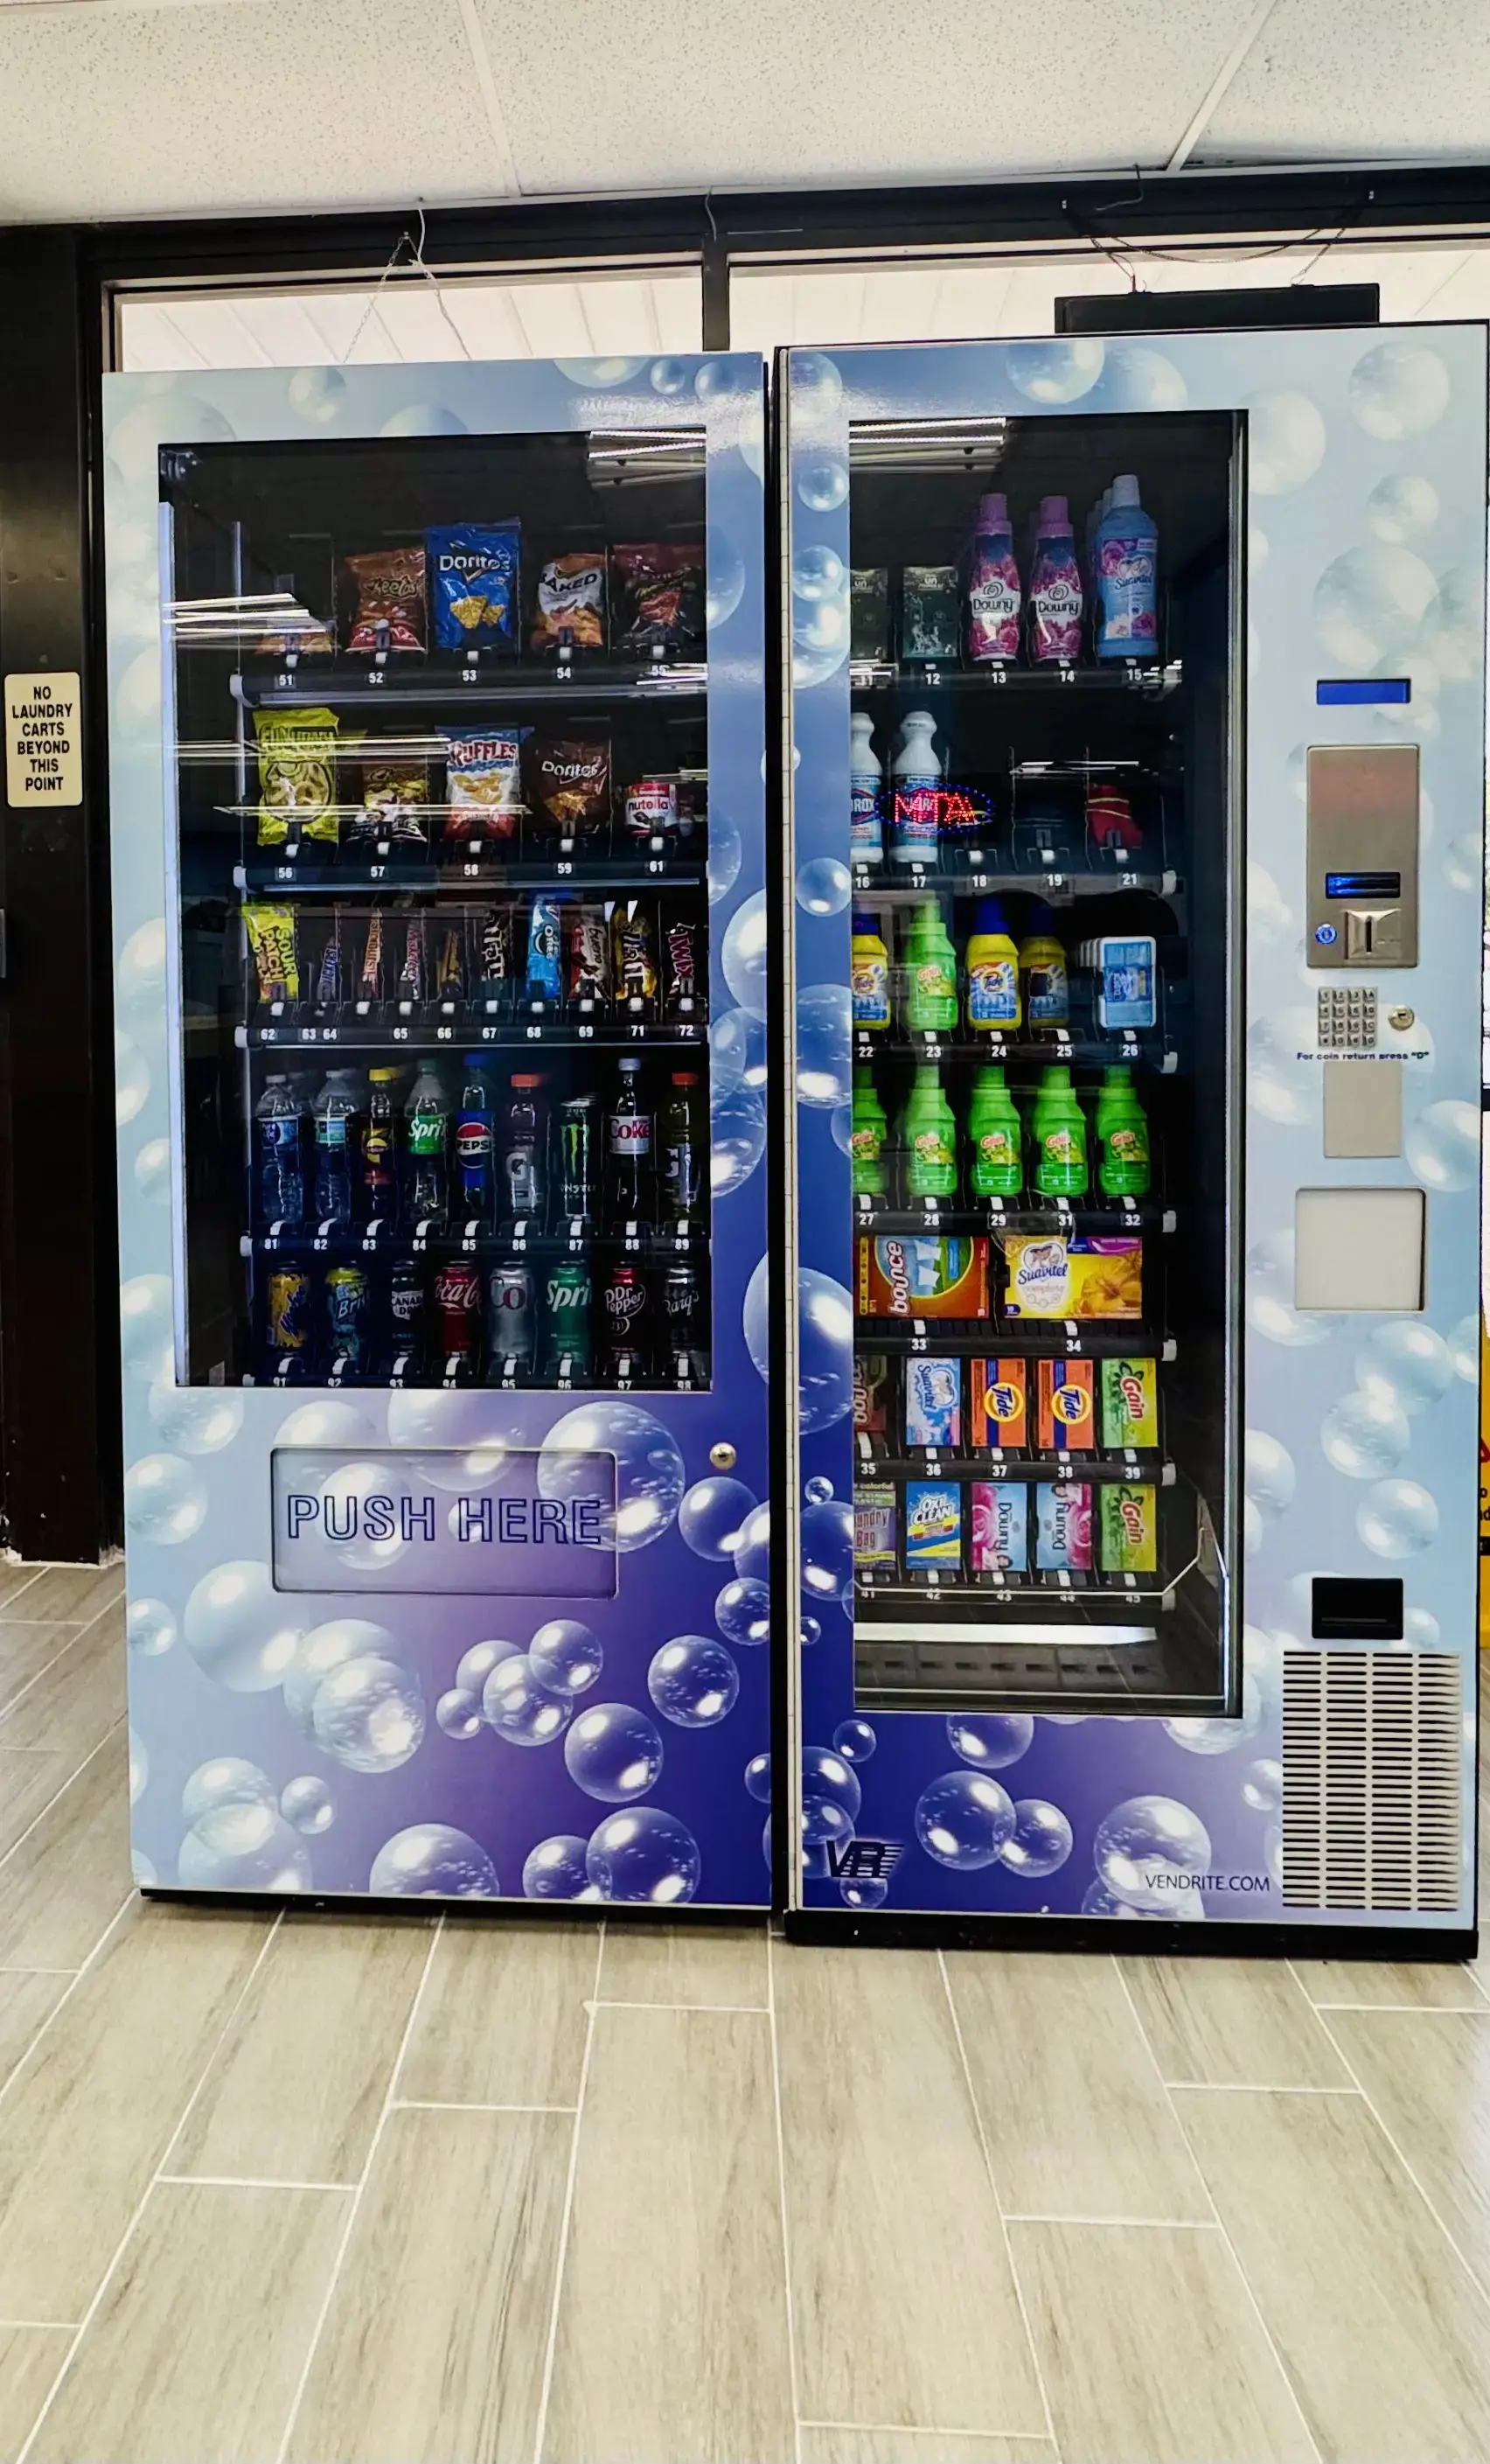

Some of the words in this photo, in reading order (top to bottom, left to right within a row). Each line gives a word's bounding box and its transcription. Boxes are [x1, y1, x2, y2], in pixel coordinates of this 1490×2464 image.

[972, 598, 1014, 612] Downy
[1038, 600, 1079, 615] Downy
[369, 673, 383, 684] 52
[462, 669, 477, 681] 53
[556, 667, 571, 679] 54
[926, 673, 940, 685] 12
[992, 672, 1006, 684] 13
[1060, 670, 1075, 682] 14
[1126, 669, 1142, 681] 15
[279, 674, 293, 686] 51
[33, 686, 52, 700] NO
[12, 703, 73, 719] LAUNDRY
[22, 722, 65, 736] CARTS
[17, 740, 70, 755] BEYOND
[30, 758, 59, 772] THIS
[25, 777, 64, 791] POINT
[628, 798, 669, 812] nutella
[278, 868, 293, 879] 56
[371, 866, 385, 877] 57
[463, 864, 478, 876] 58
[557, 862, 572, 874] 59
[856, 876, 870, 888] 16
[912, 876, 927, 888] 17
[972, 876, 987, 887] 18
[1048, 875, 1062, 887] 19
[1123, 873, 1138, 885] 21
[262, 927, 284, 980] PATCH
[275, 928, 297, 976] SOUR
[261, 1029, 275, 1040] 62
[302, 1029, 317, 1040] 63
[323, 1029, 338, 1040] 64
[393, 1028, 408, 1039] 65
[437, 1028, 452, 1039] 66
[482, 1028, 497, 1039] 67
[526, 1027, 541, 1038] 68
[579, 1026, 594, 1037] 69
[631, 1025, 644, 1037] 71
[679, 1024, 693, 1036] 72
[859, 1046, 874, 1057] 22
[926, 1045, 941, 1057] 23
[992, 1045, 1006, 1057] 24
[1057, 1045, 1072, 1057] 25
[1123, 1044, 1138, 1056] 26
[859, 1214, 874, 1225] 27
[924, 1214, 940, 1225] 28
[991, 1214, 1006, 1226] 29
[1059, 1214, 1074, 1226] 31
[1125, 1214, 1141, 1225] 32
[265, 1239, 278, 1250] 81
[314, 1239, 328, 1250] 82
[362, 1239, 377, 1250] 83
[413, 1239, 427, 1251] 84
[462, 1239, 477, 1251] 85
[512, 1239, 526, 1251] 86
[569, 1239, 584, 1251] 87
[625, 1239, 640, 1250] 88
[675, 1239, 689, 1250] 89
[887, 1240, 909, 1315] bounce
[1018, 1262, 1069, 1285] Suavitel
[615, 1286, 633, 1302] Dr
[604, 1288, 644, 1316] Pepper
[911, 1338, 927, 1351] 33
[1066, 1340, 1082, 1352] 34
[992, 1387, 1013, 1418] Tide
[1060, 1389, 1081, 1420] Tide
[1123, 1378, 1143, 1420] Gain
[860, 1463, 876, 1475] 35
[926, 1464, 941, 1476] 36
[992, 1465, 1007, 1477] 37
[1058, 1466, 1073, 1478] 38
[1125, 1467, 1140, 1479] 39
[922, 1497, 943, 1511] OXI
[288, 1495, 435, 1542] PUSH
[458, 1497, 602, 1546] HERE
[913, 1504, 952, 1525] CLEAN
[994, 1502, 1013, 1551] Downy
[1052, 1502, 1071, 1551] Downy
[1123, 1503, 1144, 1545] Gain
[1145, 1874, 1271, 1892] VENDRITE.COM
